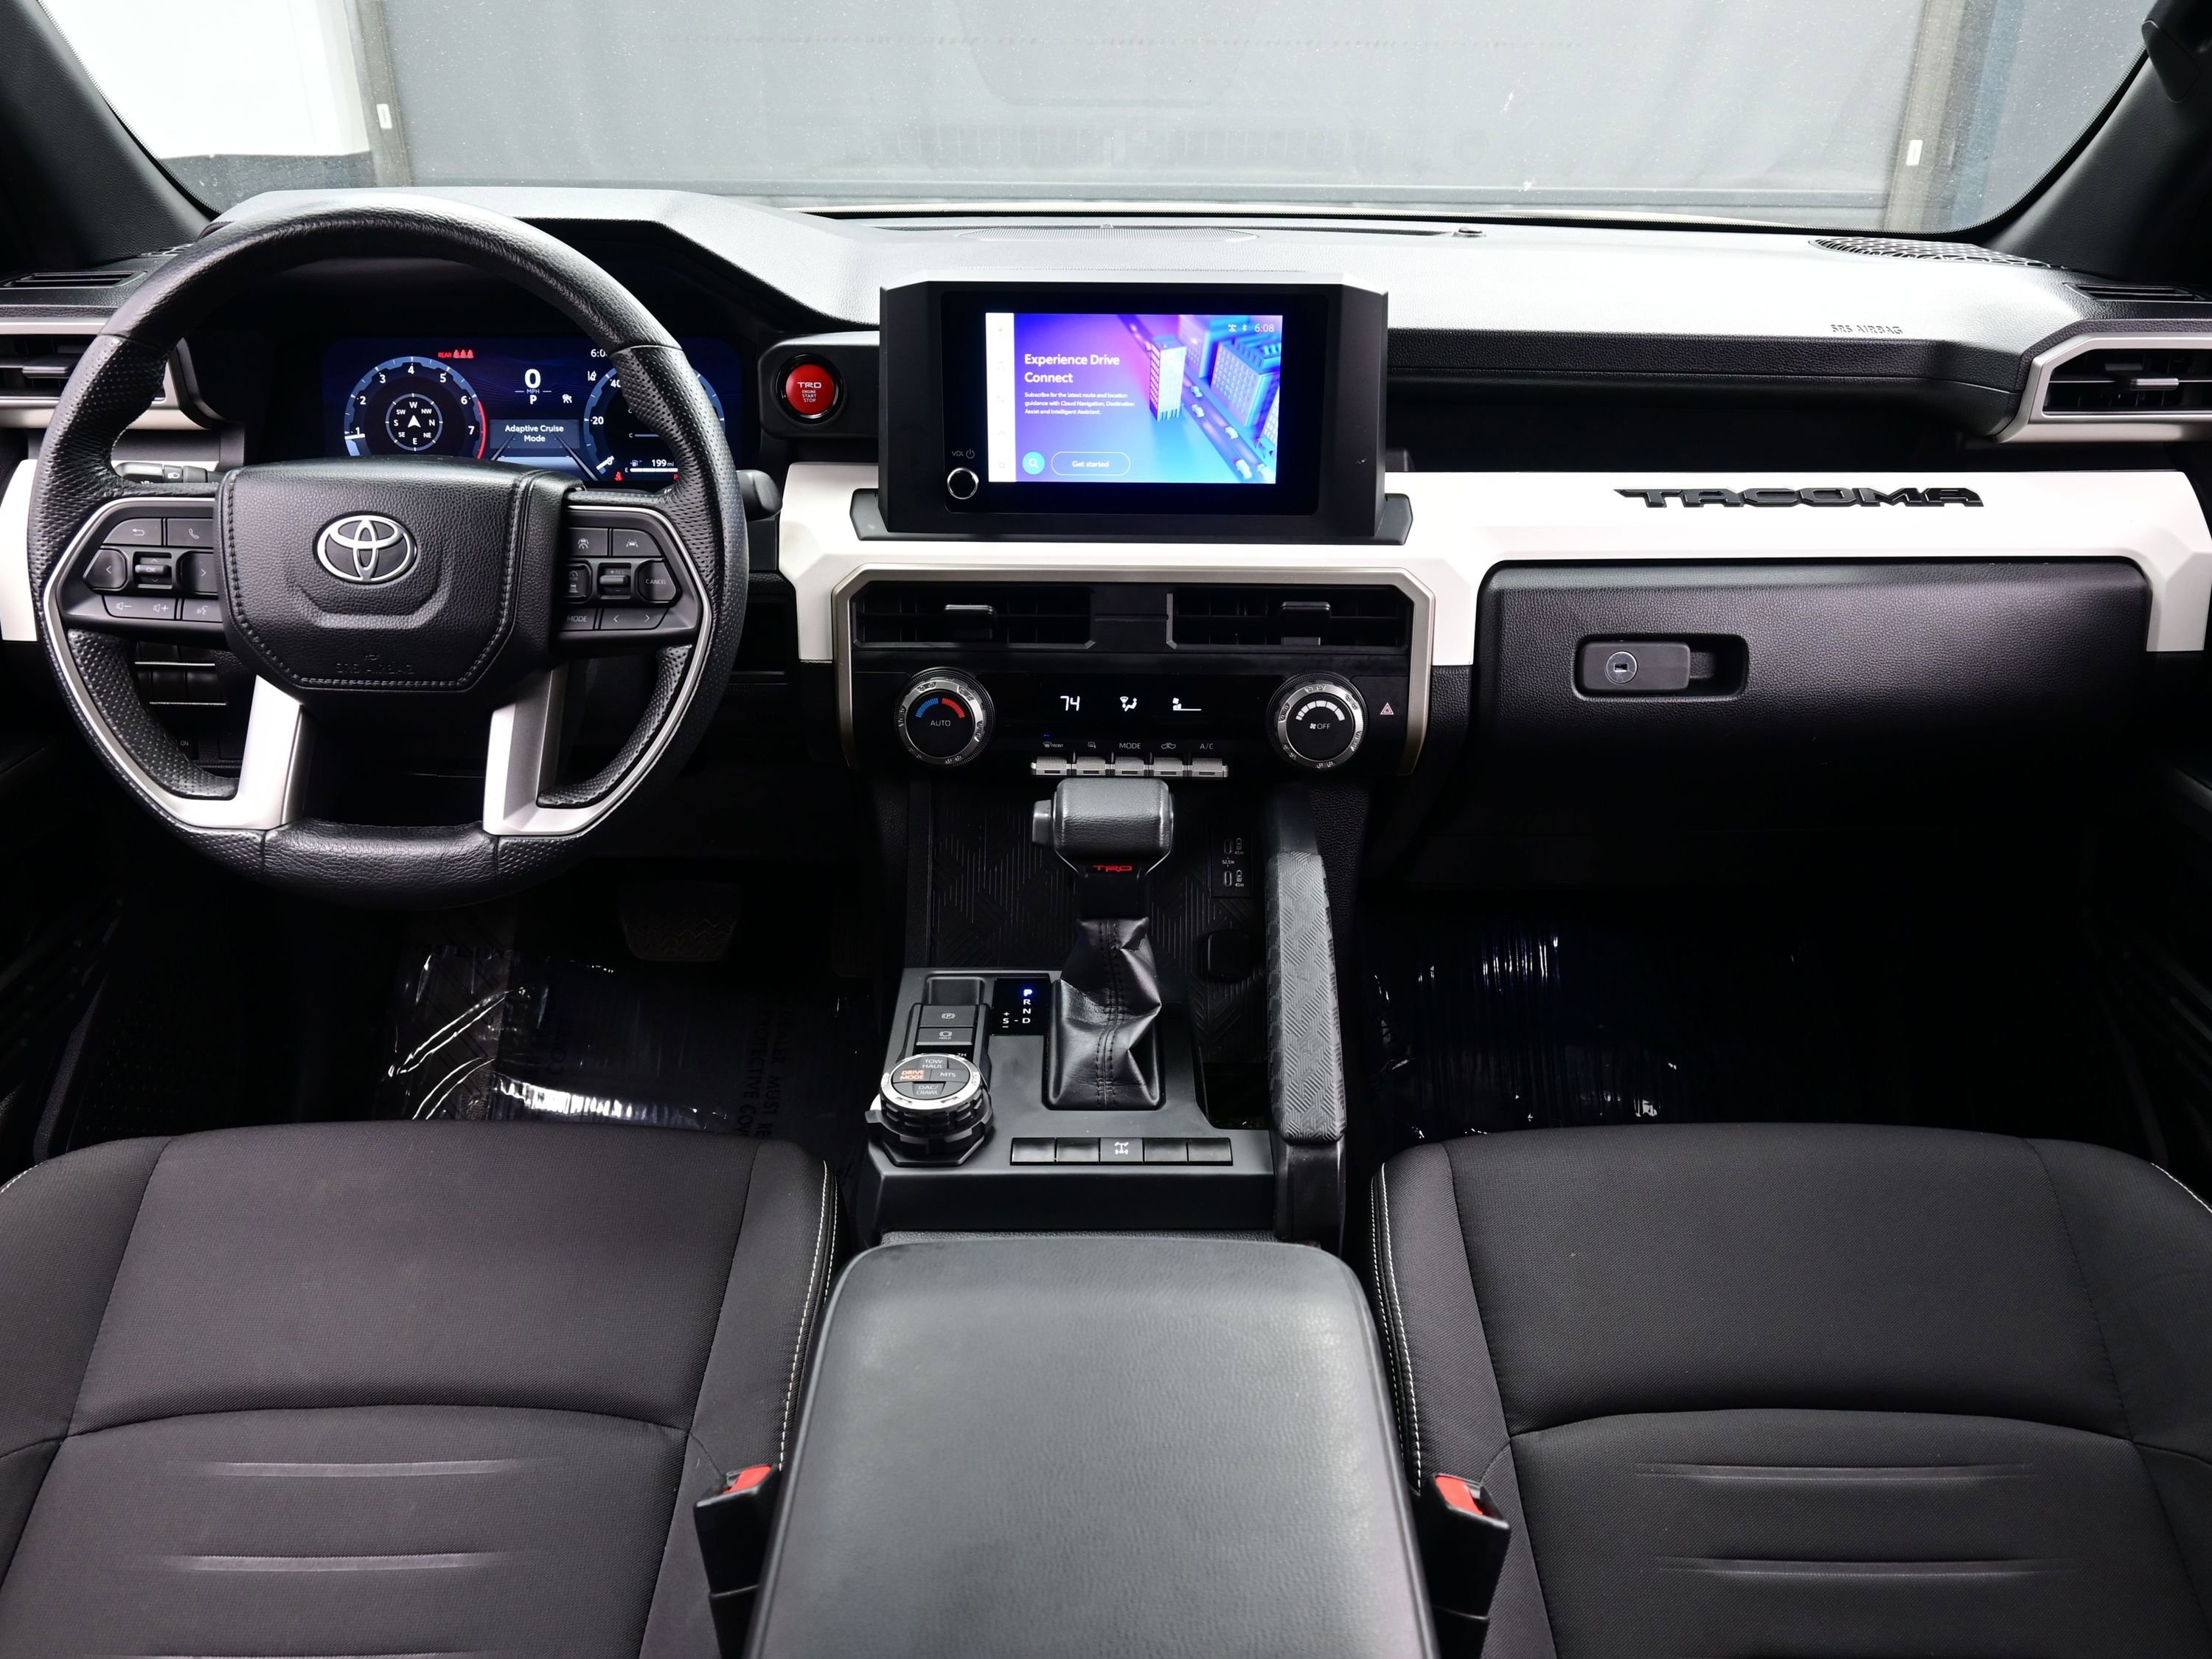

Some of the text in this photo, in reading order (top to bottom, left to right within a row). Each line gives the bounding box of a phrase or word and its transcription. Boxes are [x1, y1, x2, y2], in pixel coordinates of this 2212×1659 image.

[1254, 323, 1275, 333] 6:08
[1830, 324, 1903, 334] SRS AIRBAG
[591, 349, 608, 358] 6:0
[1024, 353, 1120, 366] Experience Drive
[408, 365, 414, 375] 4
[380, 374, 386, 383] 3
[439, 373, 446, 383] 5
[524, 368, 541, 389] 0
[1024, 372, 1074, 383] Connect
[359, 396, 366, 405] 2
[460, 395, 467, 405] 6
[529, 394, 538, 405] P
[592, 416, 605, 425] 20
[467, 425, 475, 435] 7
[504, 425, 539, 433] Adaptive
[524, 434, 546, 442] Mode
[1613, 488, 1985, 508] TACOMA
[1060, 695, 1080, 712] 74
[1092, 864, 1133, 872] TRD
[1023, 989, 1033, 997] P
[761, 1074, 782, 1115] MUST
[734, 1104, 756, 1136] COV
